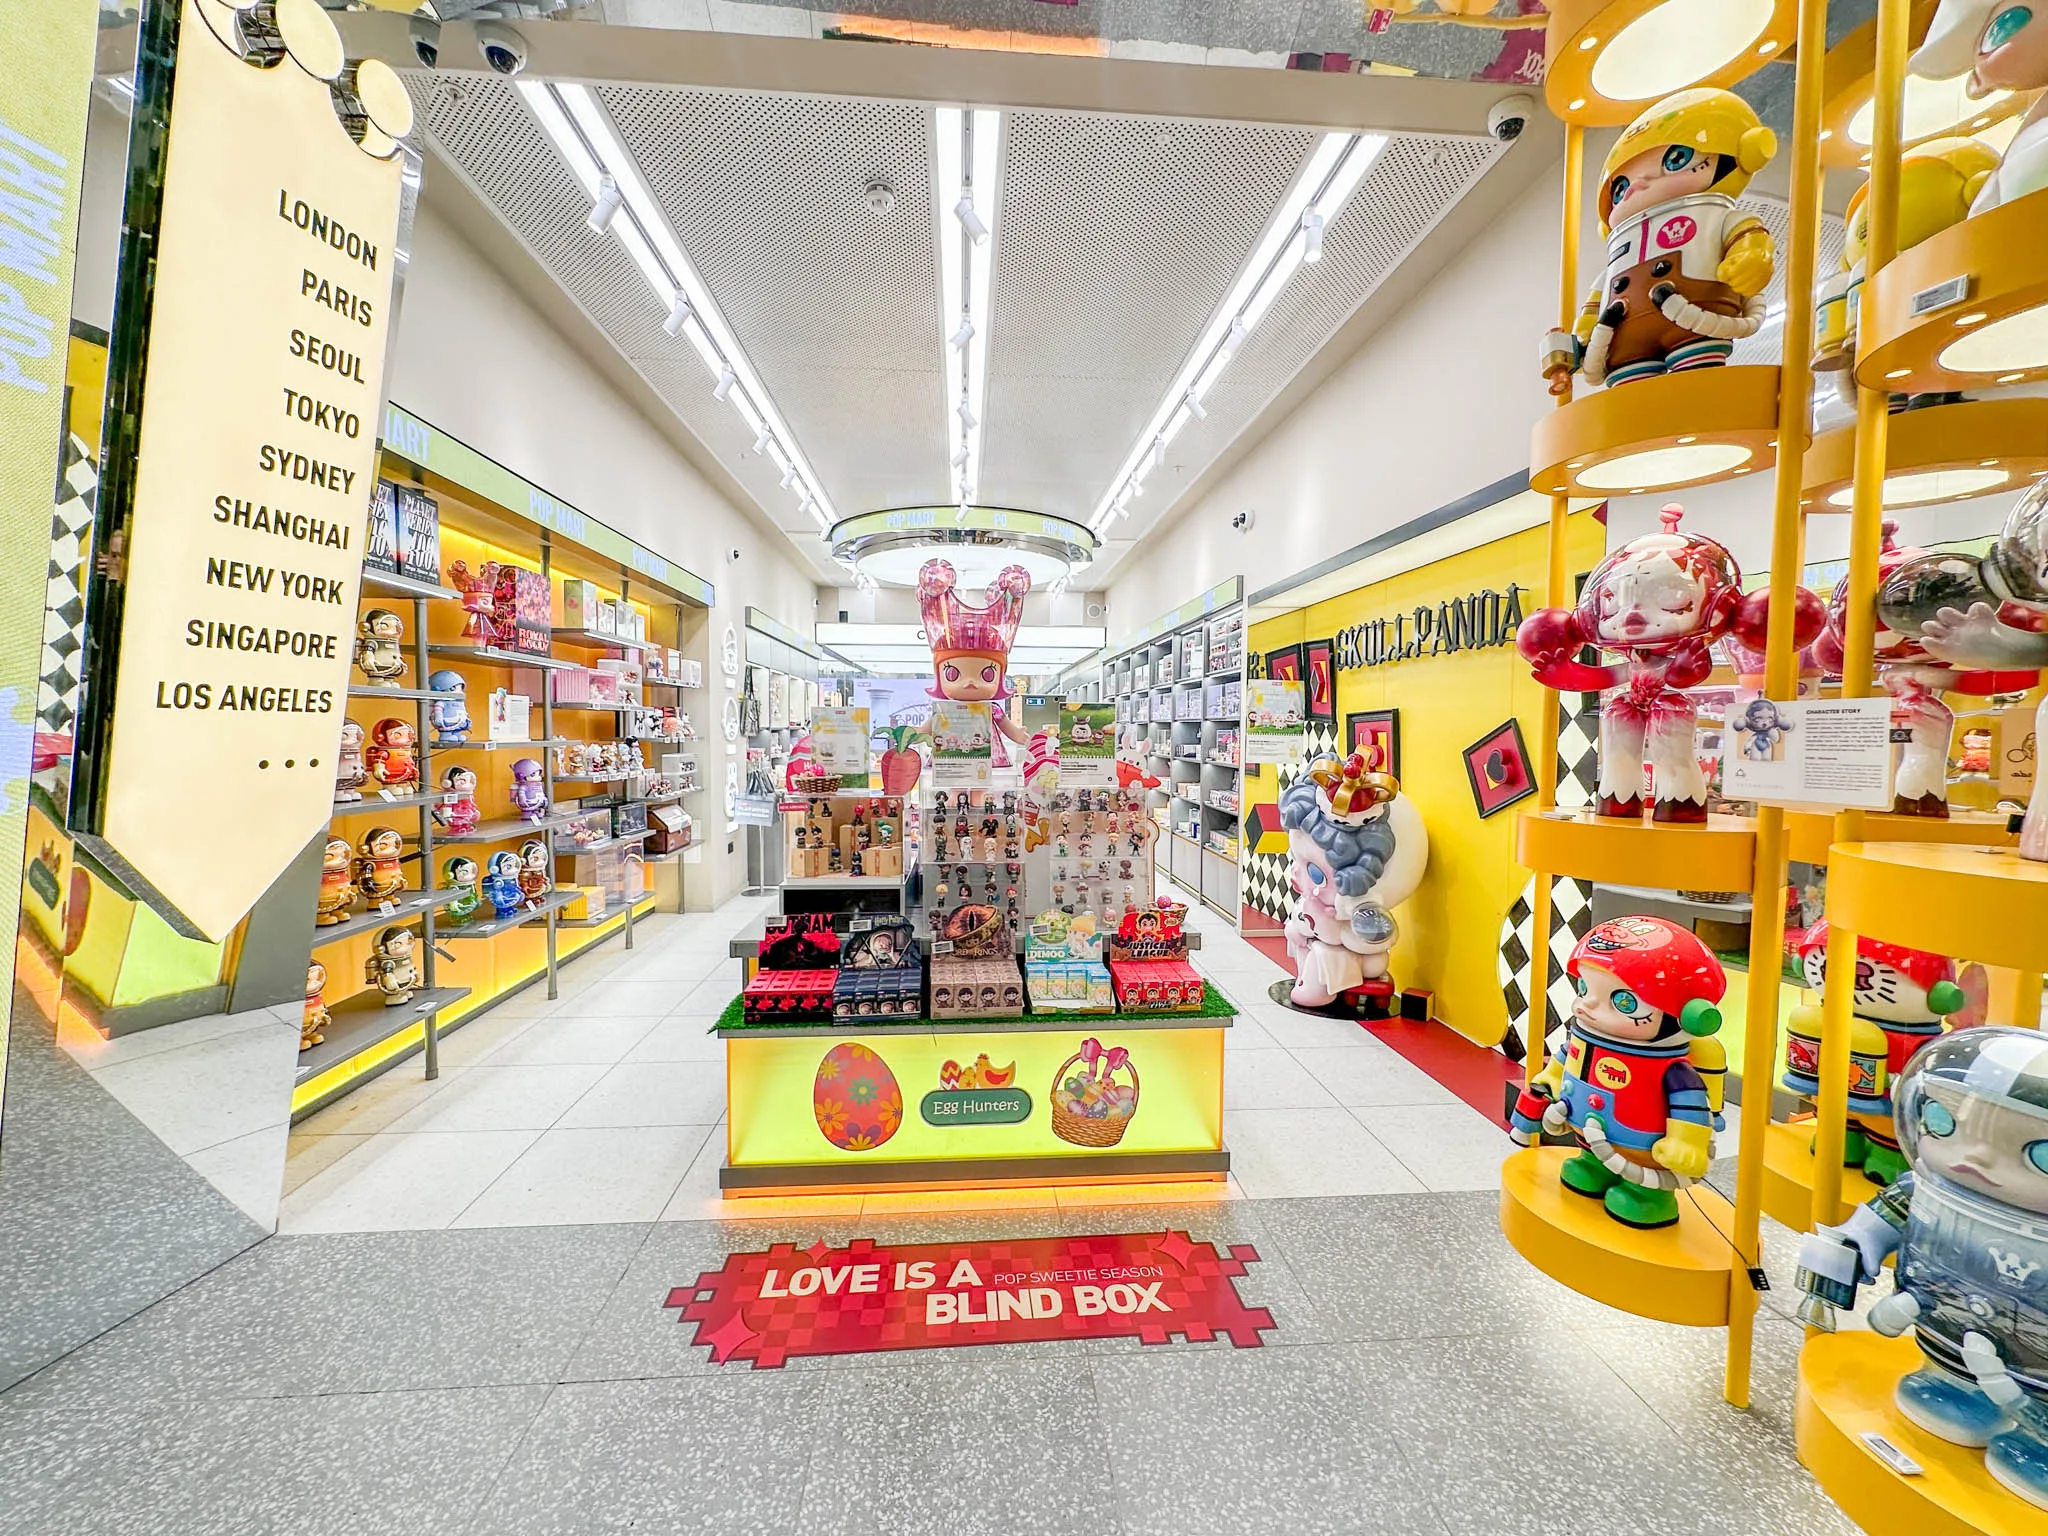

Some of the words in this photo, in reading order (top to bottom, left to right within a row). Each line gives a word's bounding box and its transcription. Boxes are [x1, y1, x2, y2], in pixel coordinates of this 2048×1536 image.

[280, 189, 378, 272] LONDON
[301, 268, 373, 328] PARIS
[289, 329, 366, 386] SEOUL
[283, 387, 360, 440] TOKYO
[259, 444, 356, 496] SYDNEY
[213, 495, 350, 553] SHANGHAI
[404, 494, 436, 521] PLANET
[405, 511, 434, 538] SERIES
[529, 489, 554, 523] POP
[556, 505, 586, 541] MART
[886, 513, 905, 528] POP
[907, 510, 936, 527] MART
[633, 547, 648, 570] POP
[208, 557, 276, 593] NEW
[280, 570, 345, 605] YORK
[186, 619, 338, 660] SINGAPORE
[518, 627, 547, 642] ROYAL
[1335, 583, 1525, 672] SKULLPANDA
[156, 681, 212, 711] LOS
[218, 685, 333, 714] ANGELES
[905, 713, 925, 727] POP
[1030, 951, 1066, 959] DIMOO
[1127, 941, 1166, 950] JUSTICE
[1131, 949, 1169, 958] LEAGUE
[933, 1101, 959, 1115] Egg
[963, 1099, 1020, 1114] Hunters
[758, 1264, 880, 1298] LOVE
[895, 1261, 936, 1291] IS
[946, 1259, 984, 1288] A
[994, 1273, 1027, 1285] POP
[1030, 1269, 1099, 1284] SWEETIE
[1101, 1265, 1164, 1280] SEASON
[925, 1287, 1064, 1325] BLIND
[1072, 1281, 1173, 1317] BOX
